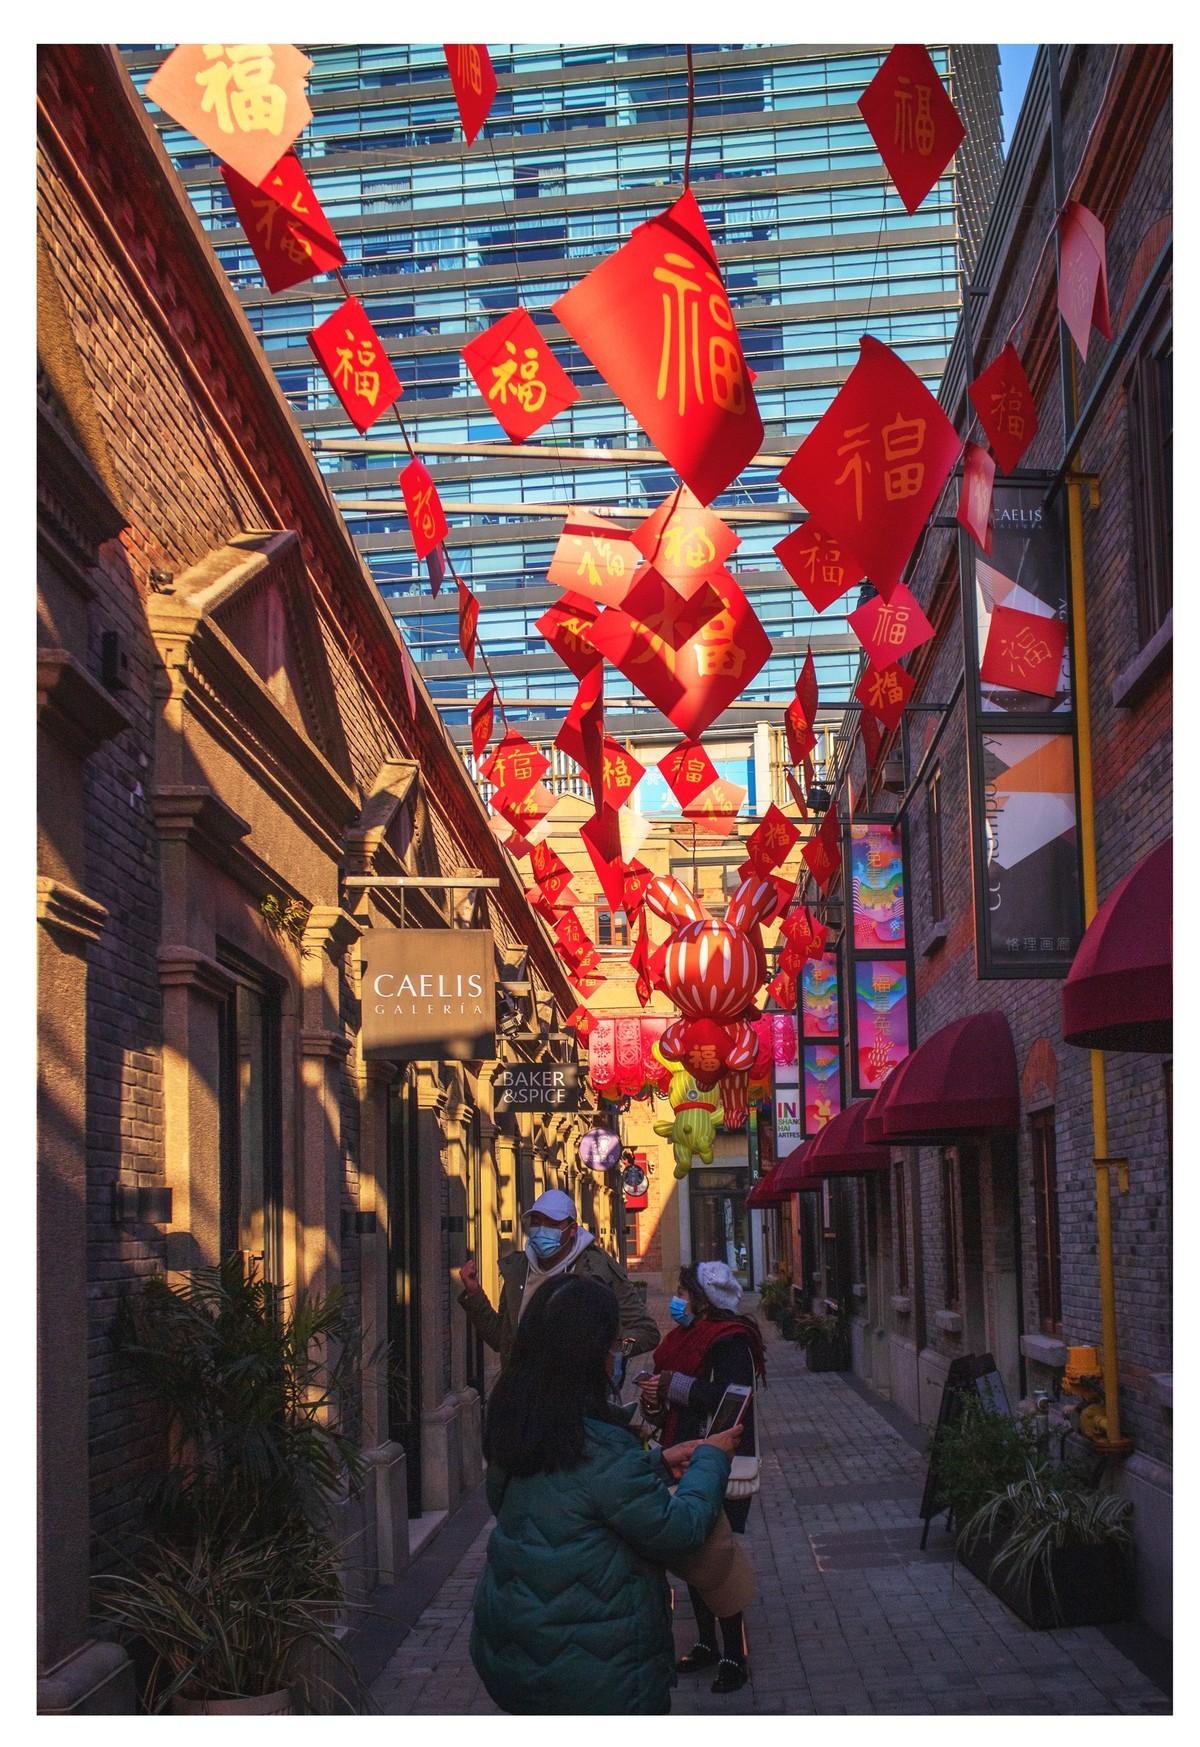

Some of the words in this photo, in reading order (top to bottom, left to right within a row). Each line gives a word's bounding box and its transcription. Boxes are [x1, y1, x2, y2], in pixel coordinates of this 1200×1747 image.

[195, 42, 288, 136] 福
[893, 75, 935, 157] 福
[653, 252, 746, 417] 福
[334, 330, 381, 406] 福
[488, 340, 547, 413] 福
[992, 381, 1024, 441] 福
[836, 412, 926, 521] 福
[411, 476, 435, 540] 福
[573, 532, 625, 586] 福
[655, 516, 715, 569] 福
[800, 532, 843, 586] 福
[872, 606, 910, 646] 福
[1001, 627, 1052, 677] 福
[868, 671, 903, 709] 福
[493, 749, 537, 787] 福
[603, 757, 632, 789] 福
[671, 756, 705, 783] 福
[765, 822, 790, 849] 福
[564, 919, 580, 942] 福
[790, 915, 811, 940] 福
[786, 949, 801, 970] 福
[374, 975, 482, 997] CAELIS
[871, 974, 892, 1037] 福星兔
[375, 1003, 482, 1015] GALERÍA
[689, 1044, 720, 1071] 福
[503, 1072, 564, 1086] BAKER
[503, 1089, 566, 1103] &SPICE
[778, 1102, 796, 1118] IN
